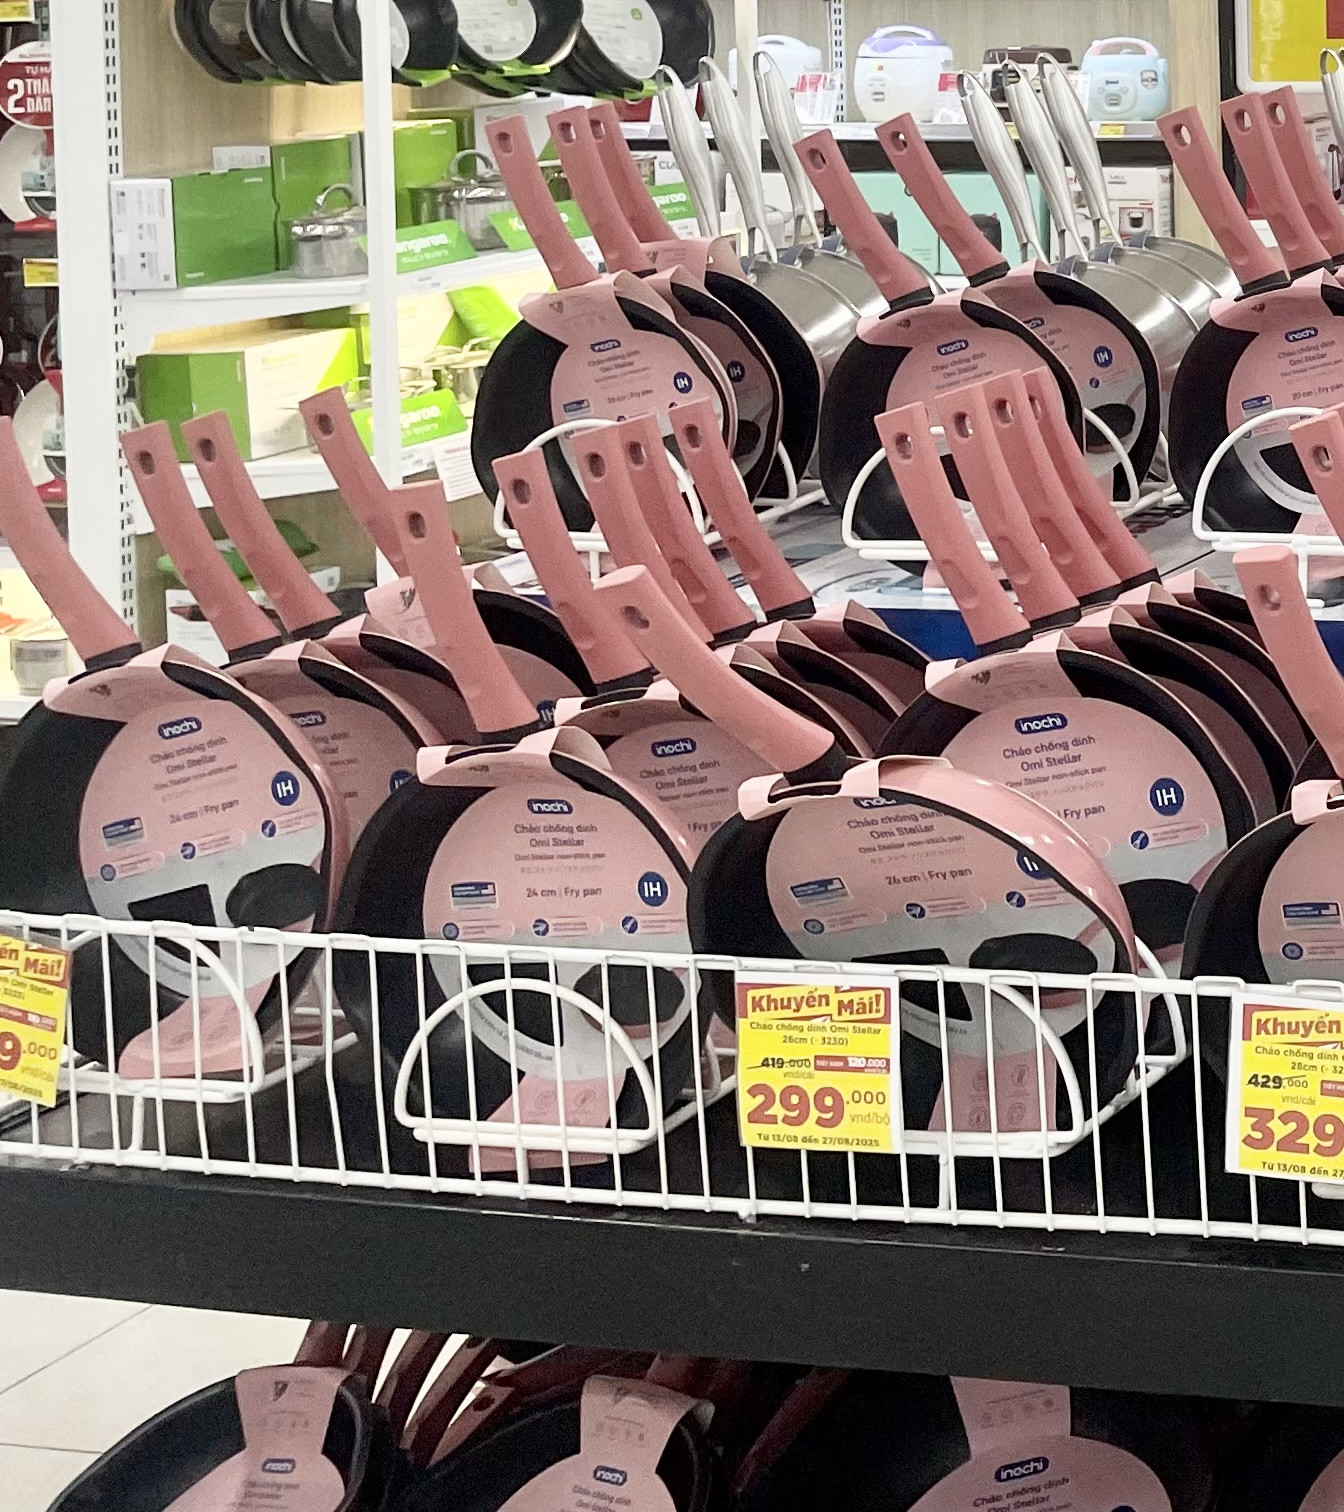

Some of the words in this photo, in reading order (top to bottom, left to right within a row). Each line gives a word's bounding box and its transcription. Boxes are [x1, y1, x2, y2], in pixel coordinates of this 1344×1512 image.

[1020, 715, 1063, 733] inochi
[751, 986, 831, 1014] Khuyến
[837, 993, 882, 1017] Mãi!
[1255, 1012, 1342, 1039] Khuyến
[1255, 1045, 1281, 1057] Chảo
[1283, 1049, 1314, 1061] chống
[1317, 1052, 1339, 1062] dính
[746, 1082, 845, 1129] 299
[849, 1111, 891, 1127] vnd/bộ
[1261, 1160, 1276, 1172] Từ
[1277, 1161, 1307, 1174] 13/08
[1309, 1164, 1329, 1177] đến
